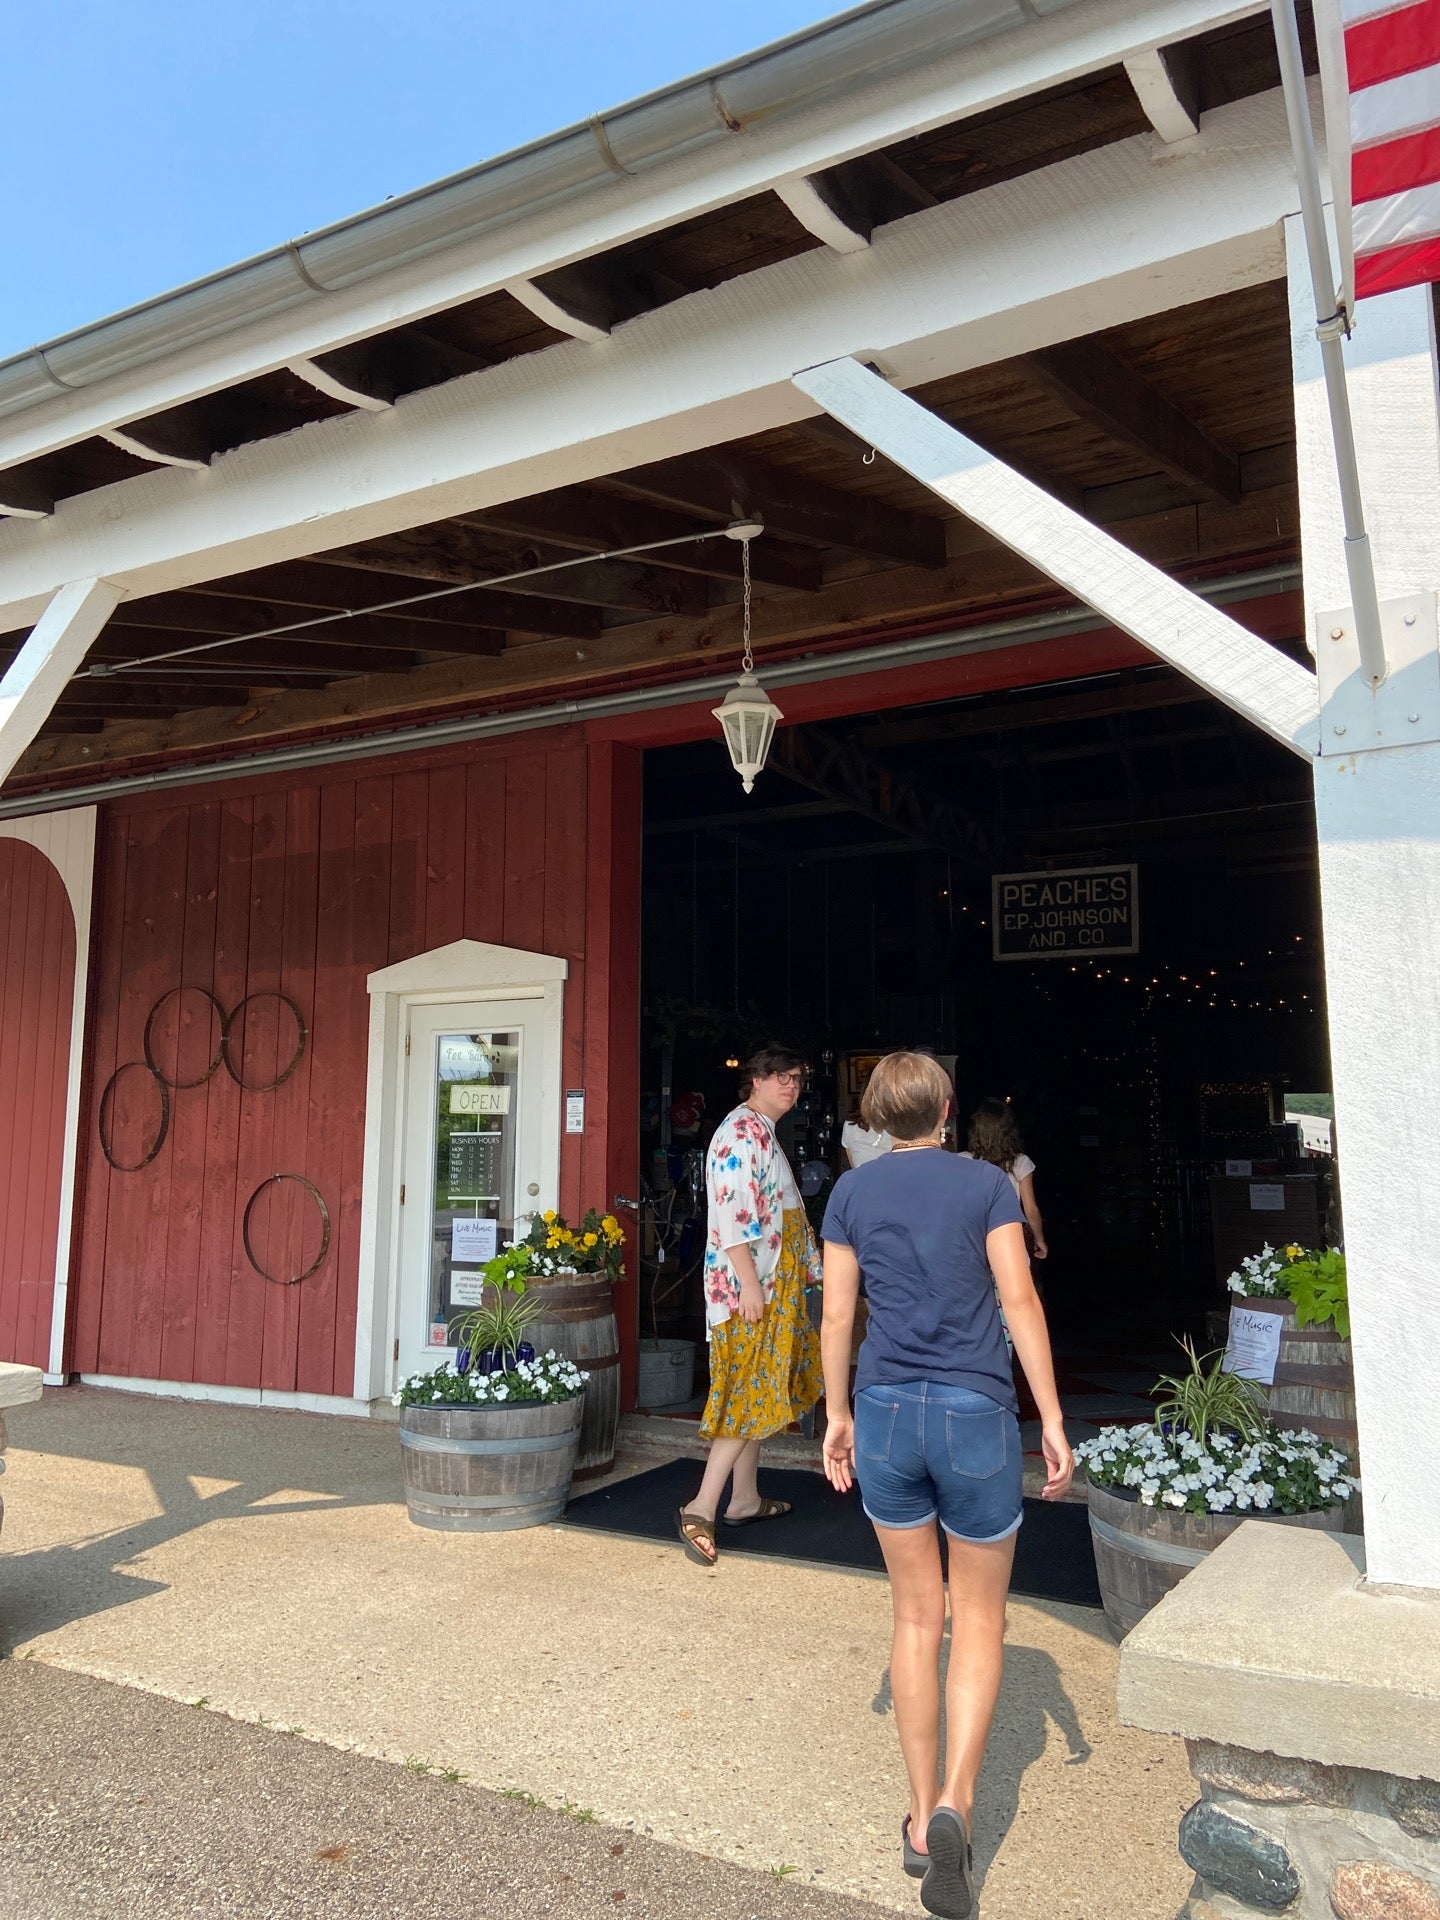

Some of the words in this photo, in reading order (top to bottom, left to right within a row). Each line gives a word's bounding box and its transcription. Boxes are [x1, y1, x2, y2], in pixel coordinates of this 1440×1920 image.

[1004, 876, 1127, 908] PEACHES
[1028, 930, 1066, 948] AND
[1078, 928, 1105, 945] CO
[460, 1091, 500, 1110] OPEN
